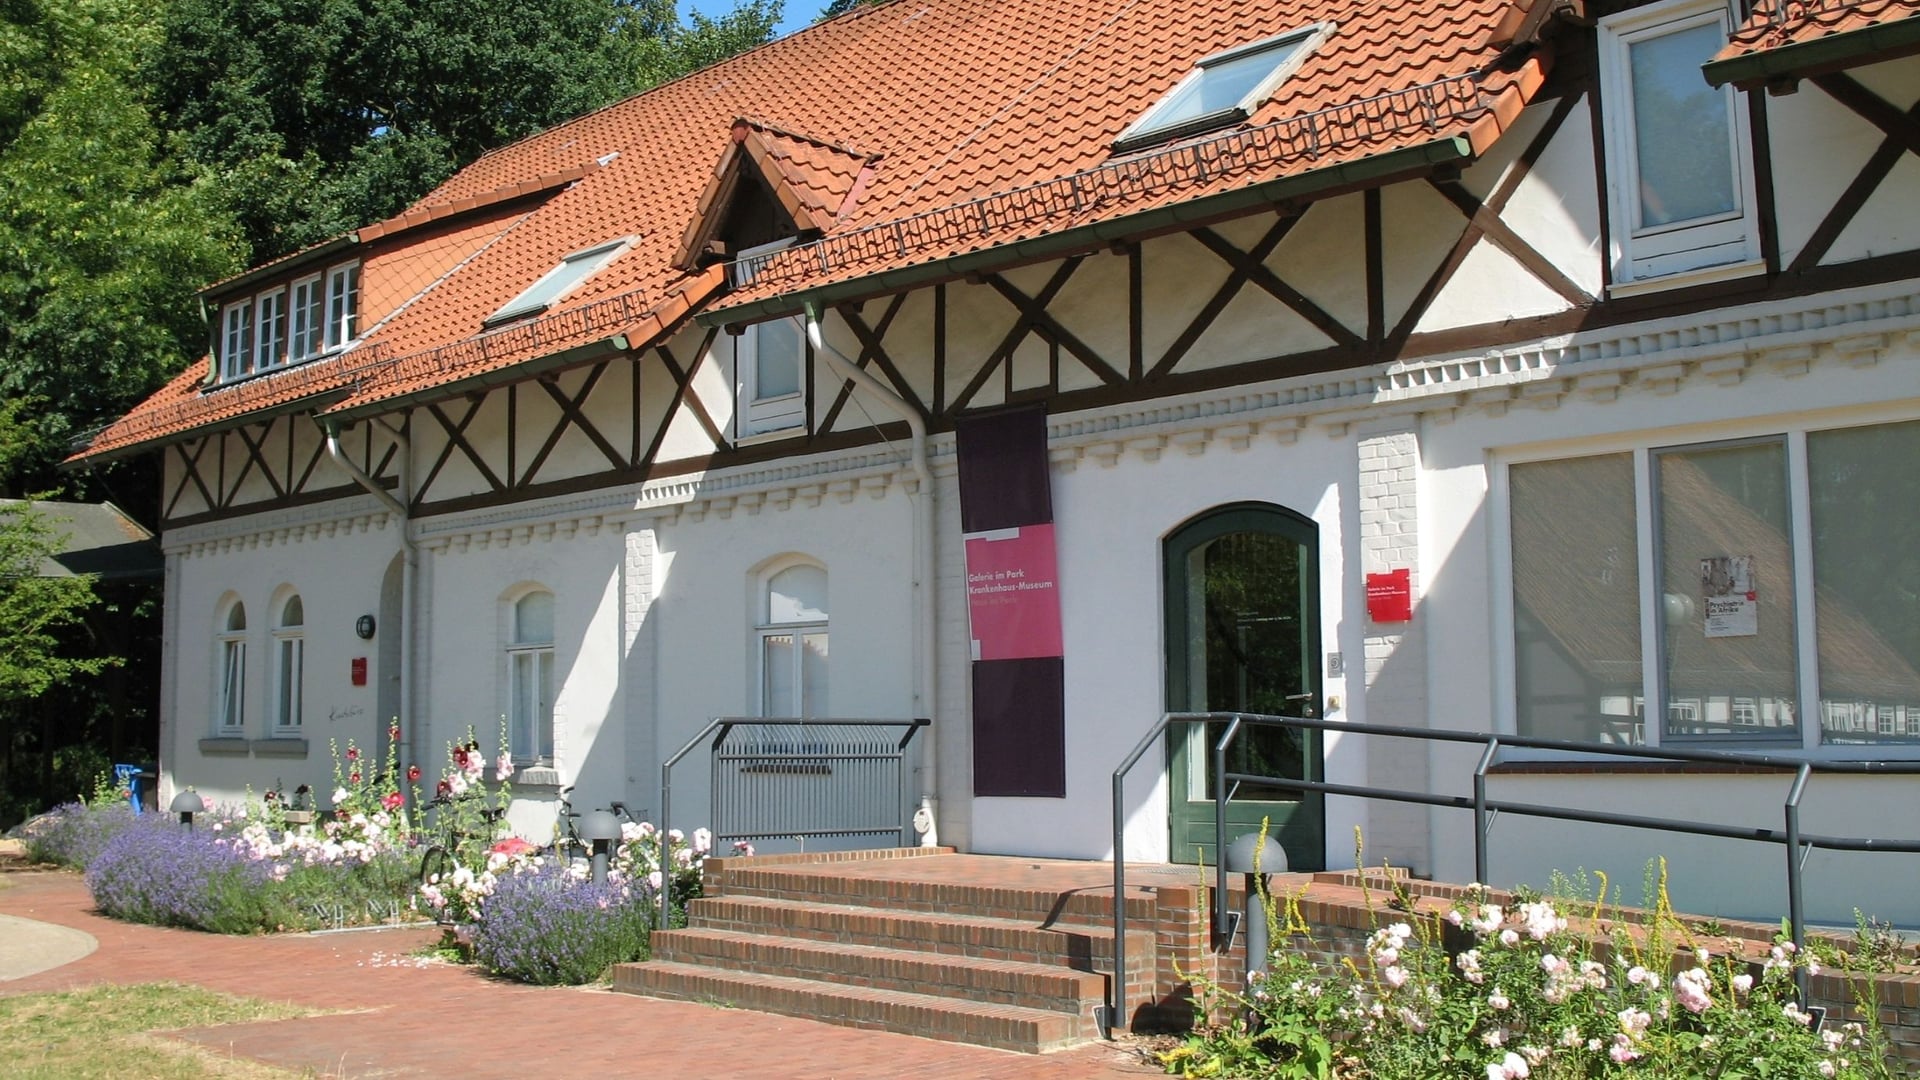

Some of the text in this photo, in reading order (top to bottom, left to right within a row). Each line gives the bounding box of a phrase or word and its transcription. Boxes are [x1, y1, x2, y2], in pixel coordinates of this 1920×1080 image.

[969, 569, 1024, 582] Galerie im Park
[969, 581, 1053, 594] Krankenhaus-Museum
